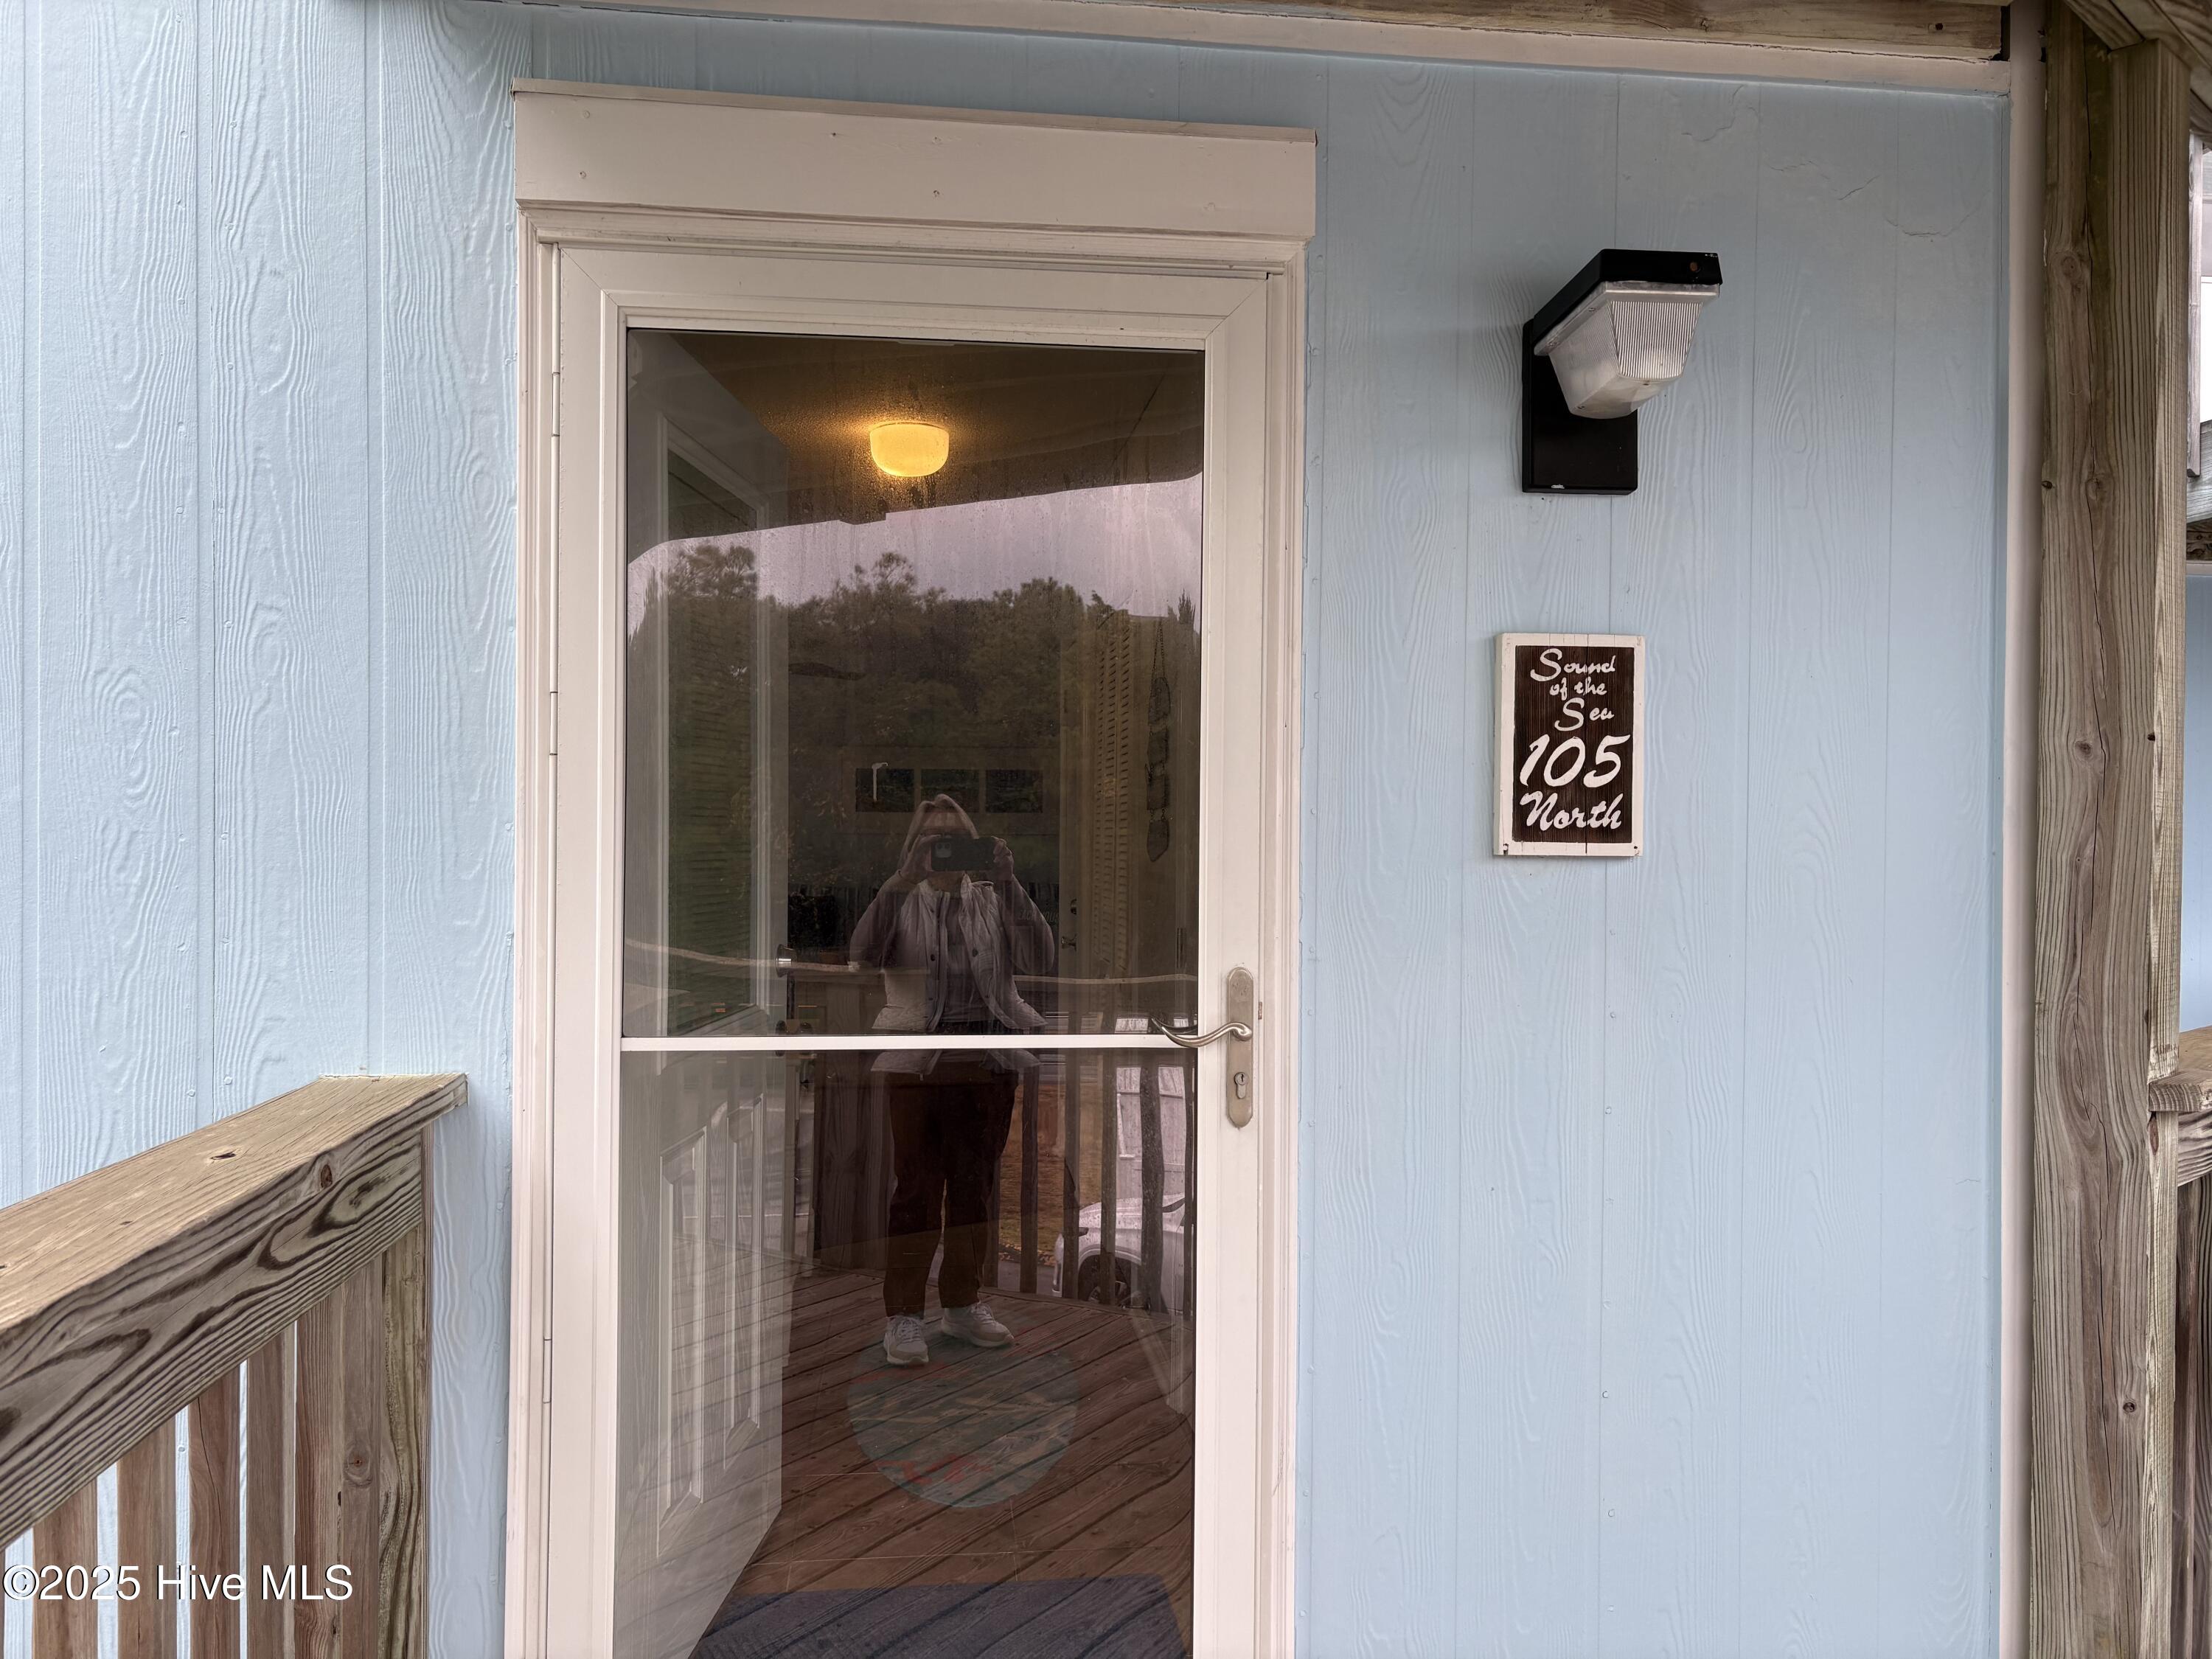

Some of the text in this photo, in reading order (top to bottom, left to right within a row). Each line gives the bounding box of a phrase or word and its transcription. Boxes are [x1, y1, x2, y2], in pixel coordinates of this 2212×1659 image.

[1530, 648, 1616, 681] Sound
[1549, 677, 1607, 700] of the
[1554, 698, 1615, 731] Sea
[1520, 734, 1631, 787] 105
[1519, 790, 1624, 830] North
